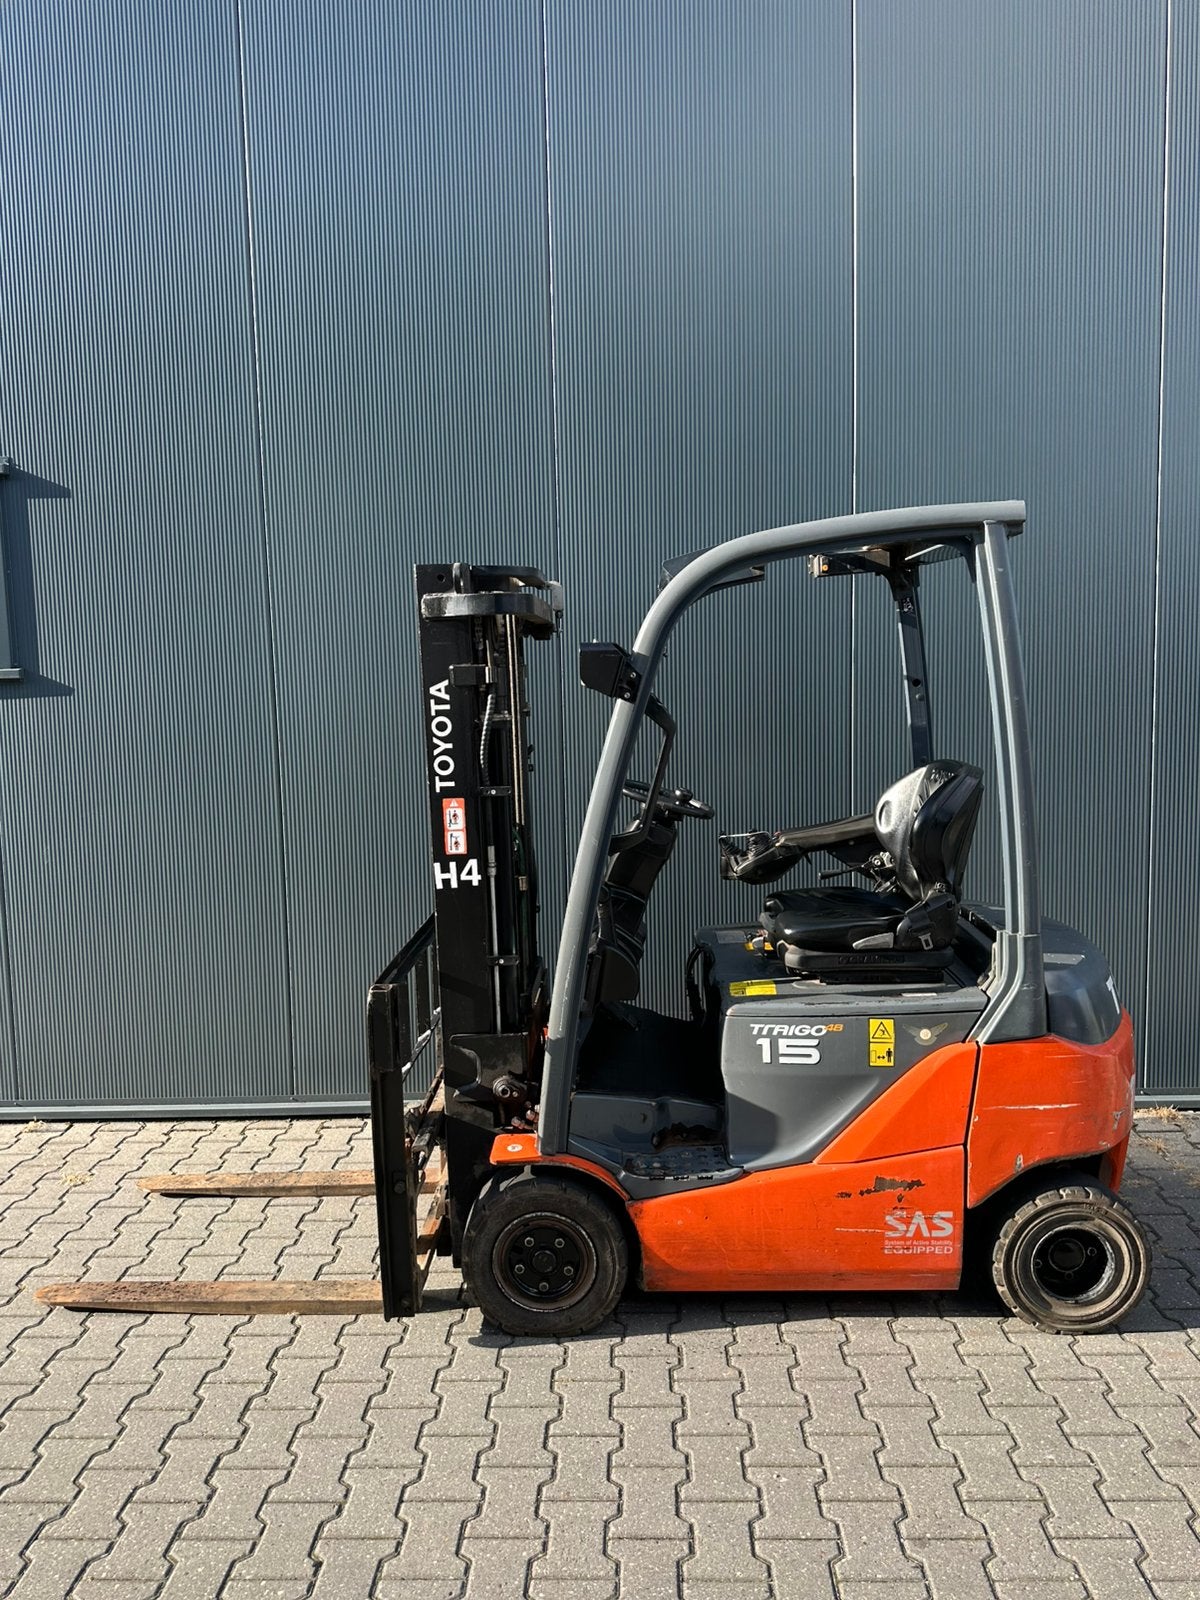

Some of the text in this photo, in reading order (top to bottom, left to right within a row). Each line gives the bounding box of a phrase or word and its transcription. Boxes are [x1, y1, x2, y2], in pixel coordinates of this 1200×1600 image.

[429, 679, 456, 793] TOYOTA
[433, 858, 482, 890] H4
[756, 1037, 821, 1065] 15
[885, 1210, 954, 1237] SAS
[884, 1246, 954, 1254] EQUIPPED
